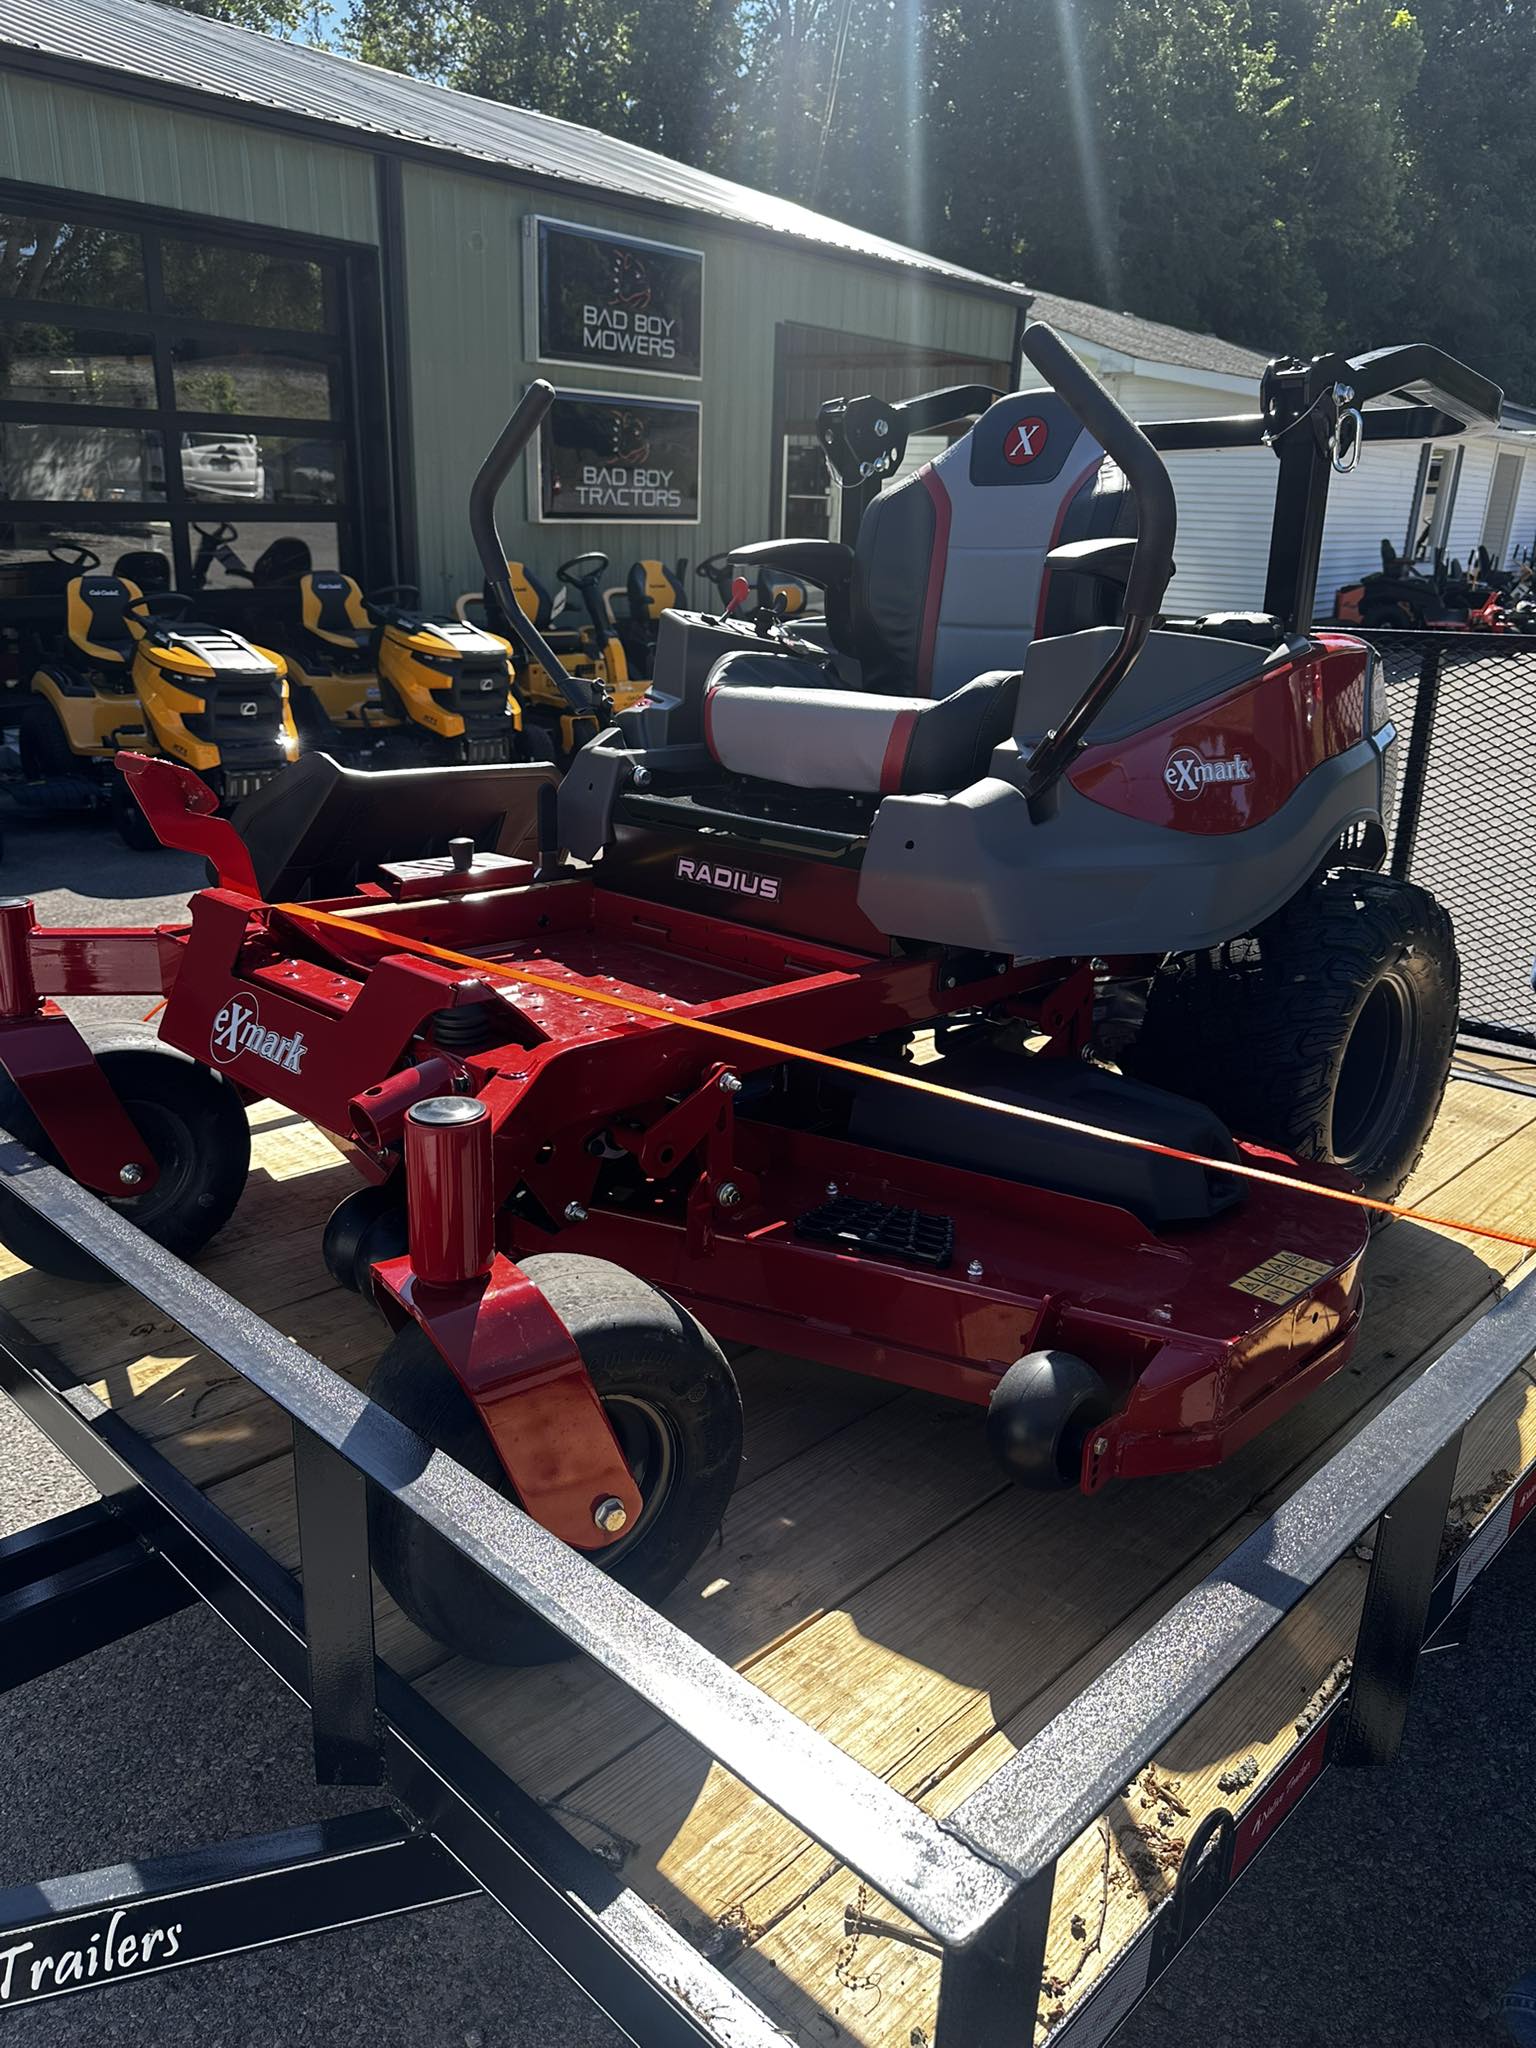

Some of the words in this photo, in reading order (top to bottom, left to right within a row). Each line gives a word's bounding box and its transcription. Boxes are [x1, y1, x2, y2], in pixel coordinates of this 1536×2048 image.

[583, 305, 628, 330] BAD
[634, 313, 675, 337] BOY
[583, 327, 675, 359] MOWERS
[1009, 424, 1040, 457] X
[583, 466, 627, 486] BAD
[633, 468, 674, 487] BOY
[575, 486, 681, 507] TRACTORS
[678, 859, 779, 899] RADIUS
[0, 1910, 183, 1999] Trailers
